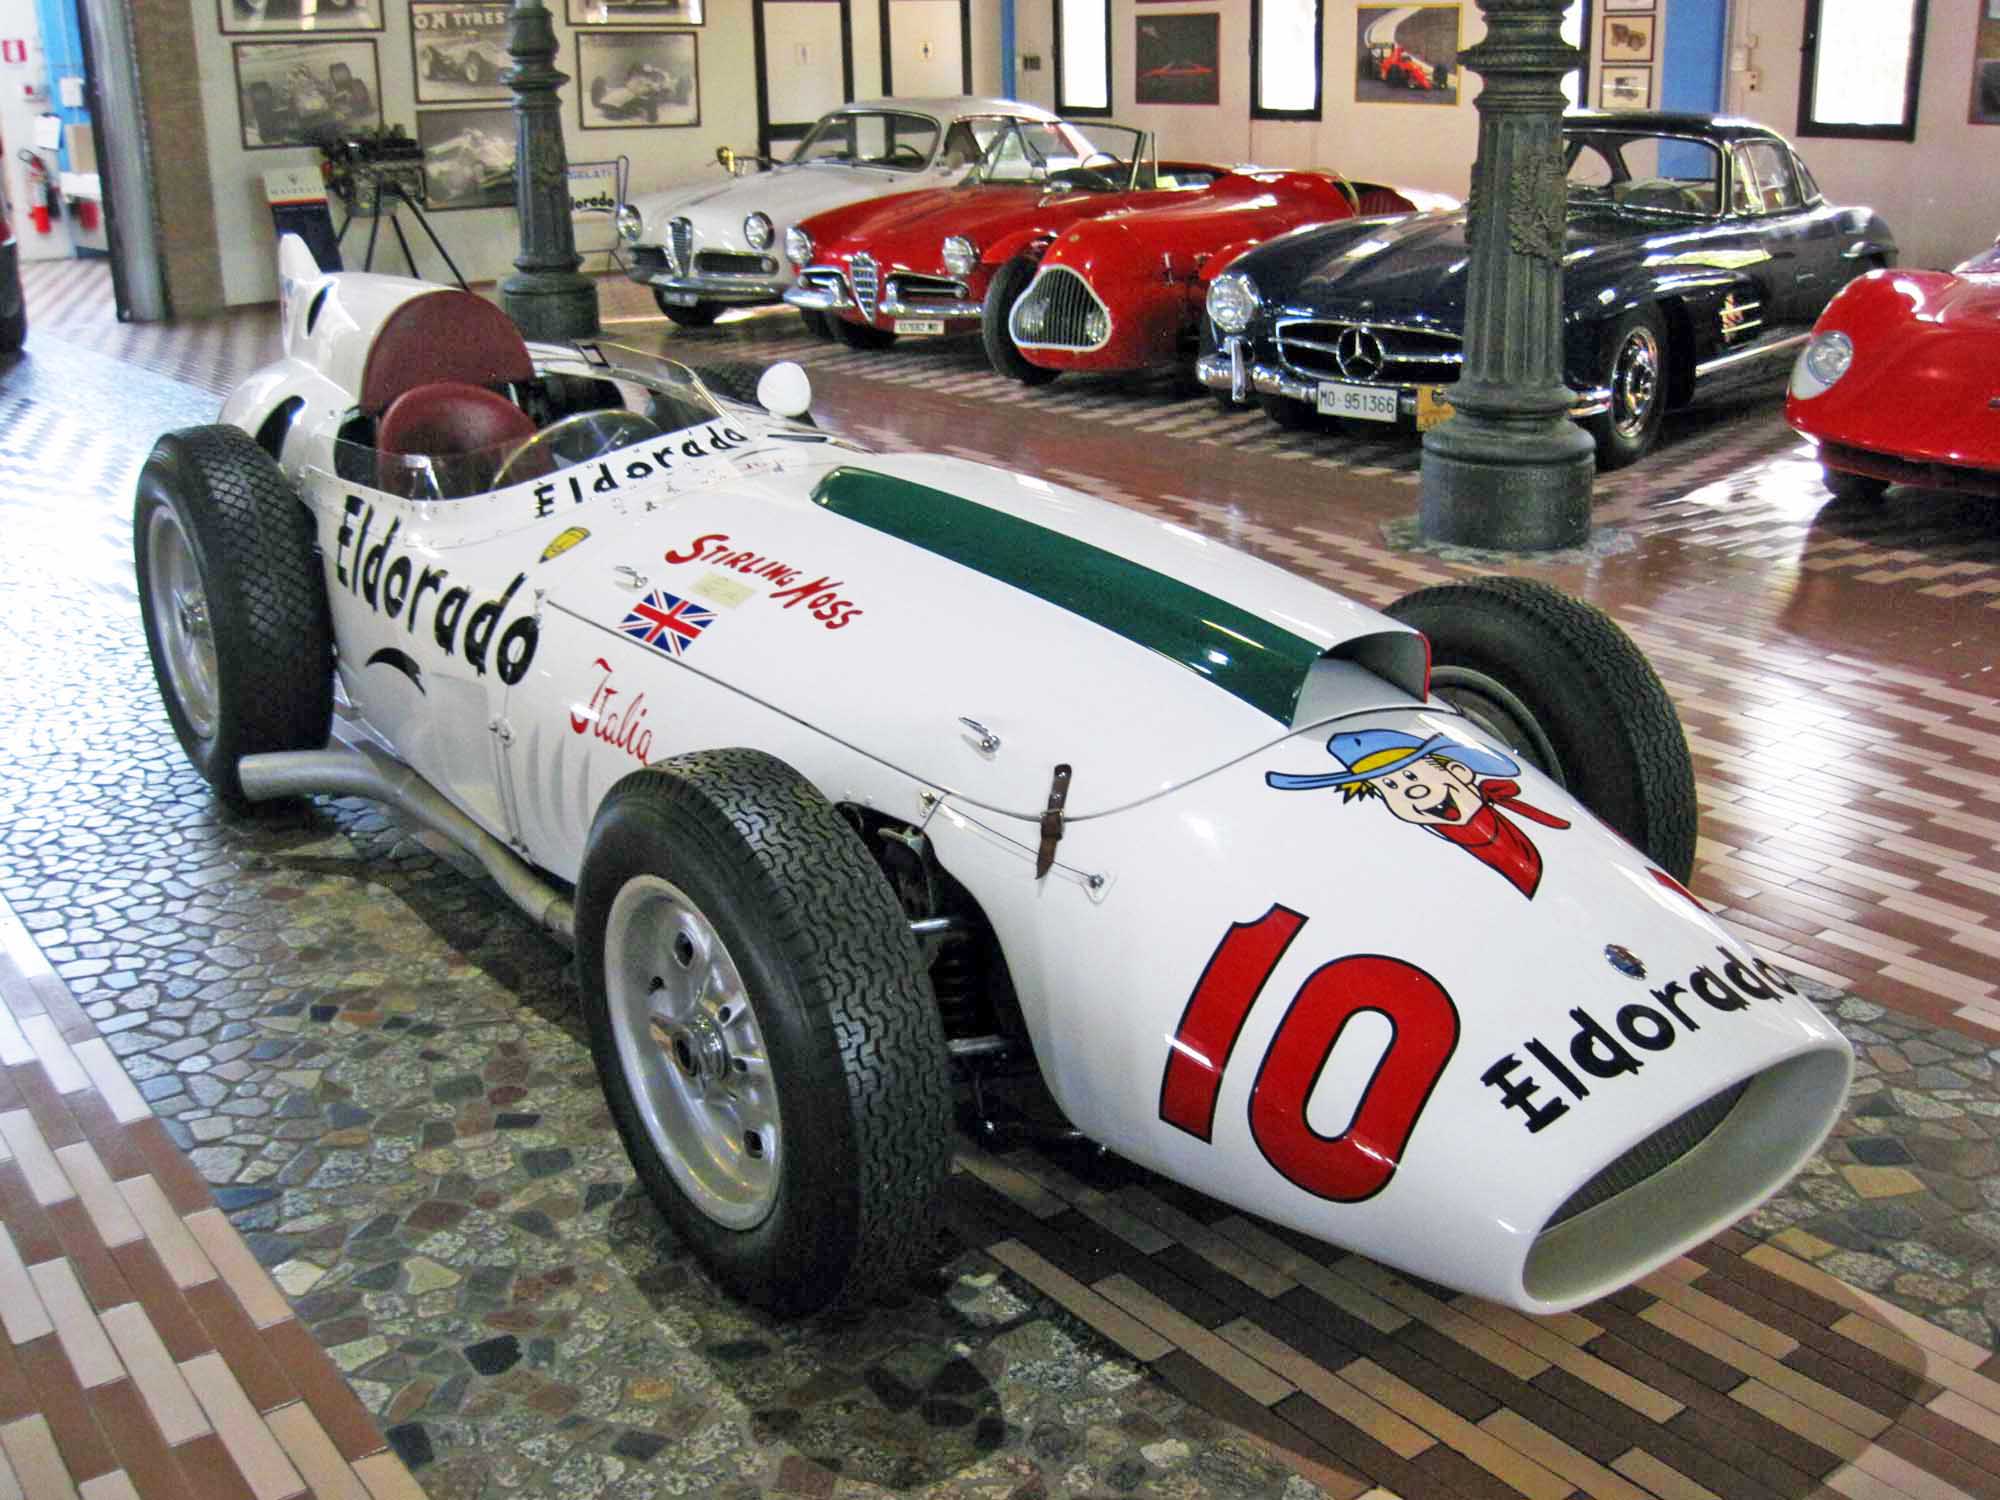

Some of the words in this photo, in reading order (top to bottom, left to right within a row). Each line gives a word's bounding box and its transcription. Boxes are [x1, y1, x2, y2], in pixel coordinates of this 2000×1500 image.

[453, 11, 505, 25] TYRES
[534, 425, 749, 520] Eldorado
[336, 494, 540, 686] Eldorado
[570, 657, 653, 768] Italia
[1158, 902, 1461, 1204] 10
[1480, 945, 1798, 1134] Eldorado
